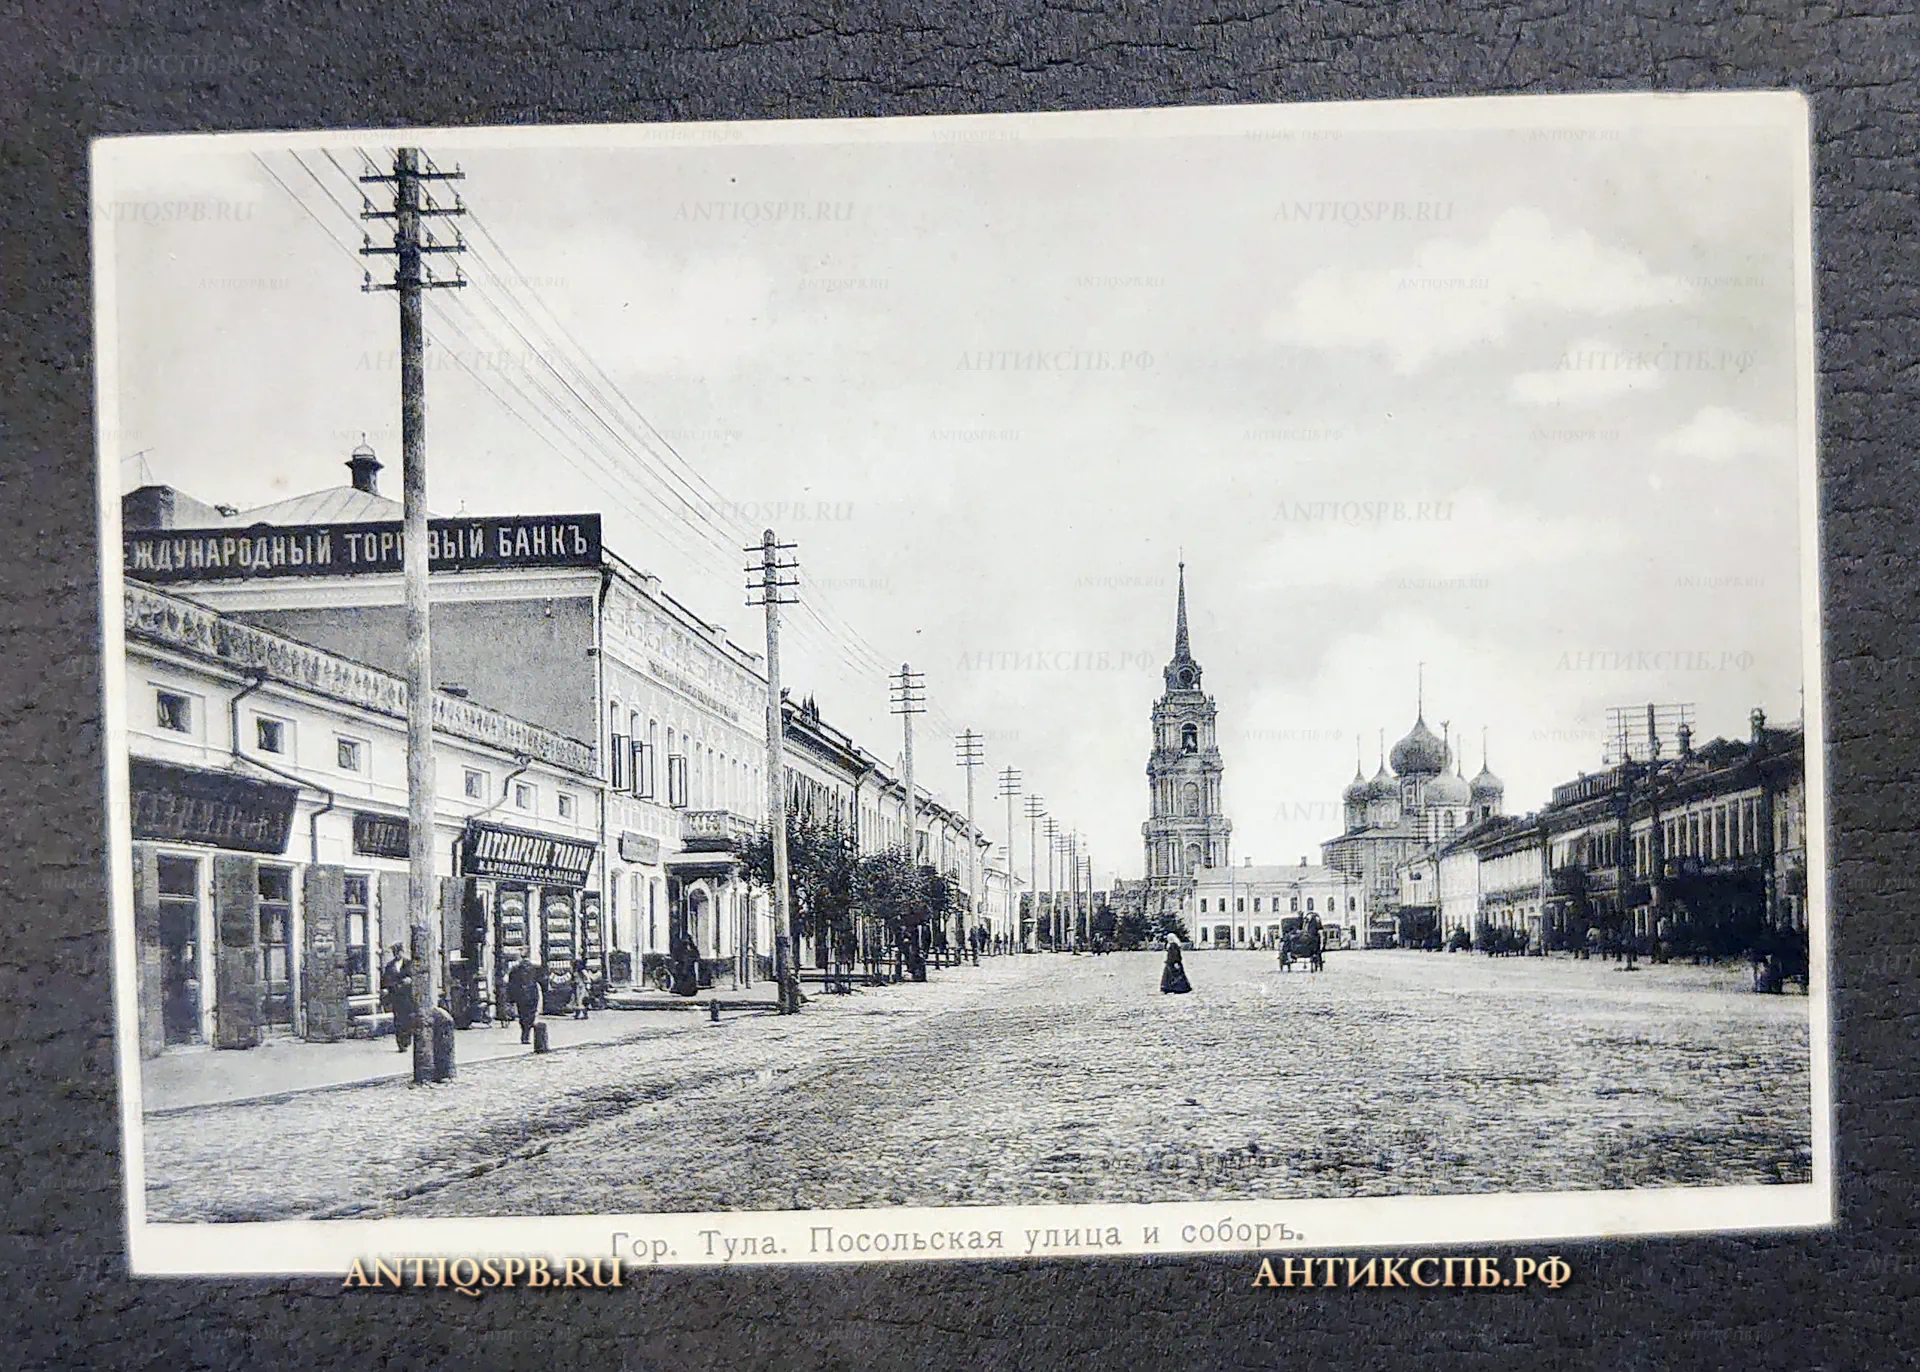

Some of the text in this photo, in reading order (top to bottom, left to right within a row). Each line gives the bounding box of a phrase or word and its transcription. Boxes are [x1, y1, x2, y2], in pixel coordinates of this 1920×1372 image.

[344, 523, 485, 564] ТОРГВЫЙ
[498, 523, 589, 558] БАНКЪ
[611, 1217, 1305, 1264] Гор. Тула. Посольская улица и соборъ.
